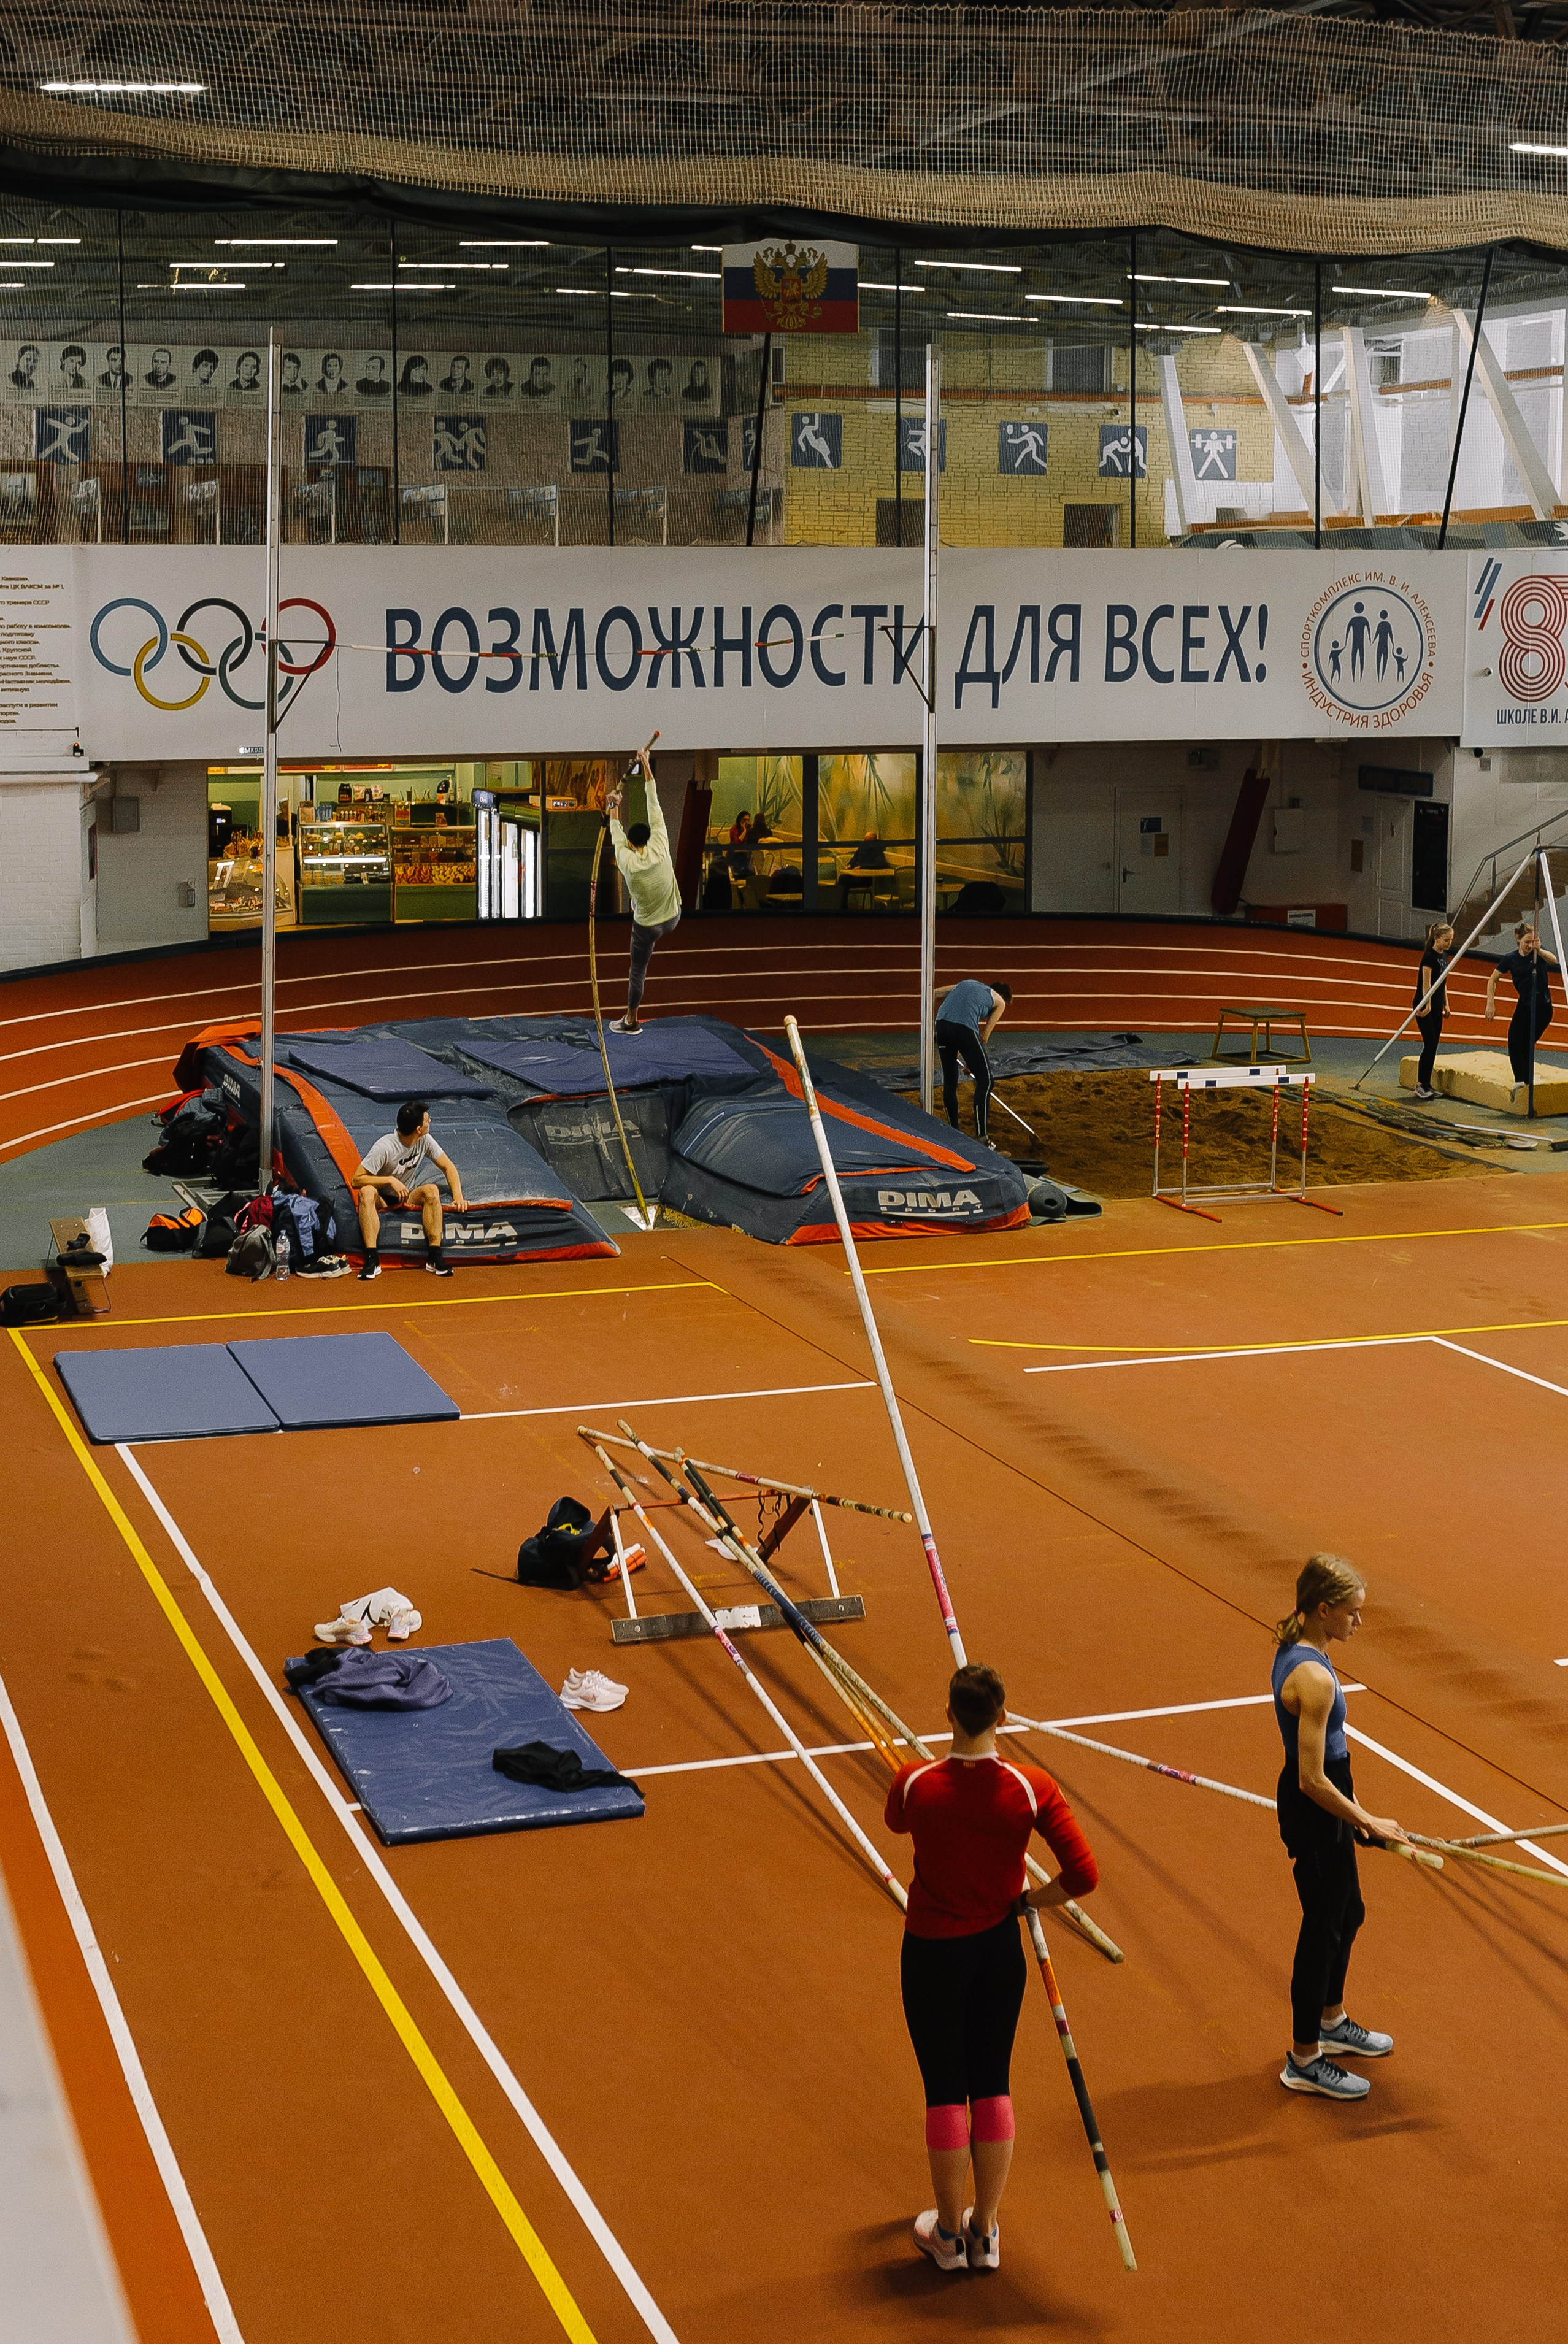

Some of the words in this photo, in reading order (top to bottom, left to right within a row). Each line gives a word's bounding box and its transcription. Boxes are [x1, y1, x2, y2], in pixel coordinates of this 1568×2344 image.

[1301, 572, 1361, 658] СПОРТКОМПЛЕКС
[1365, 572, 1386, 582] ИМ.
[1410, 593, 1437, 658] АЛЕКСЕЕВА
[385, 604, 925, 694] ВОЗМОЖНОСТИ
[954, 604, 1082, 710] ДЛЯ
[1106, 604, 1269, 685] ВСЕХ!
[1301, 671, 1369, 728] ИНДУСТРИЯ
[1373, 672, 1434, 729] ЗДОРОВЬЯ
[1497, 709, 1537, 724] ШКОЛЕ
[1540, 708, 1561, 724] В.И.
[878, 1189, 982, 1208] DIMA
[401, 1221, 518, 1239] DMA
